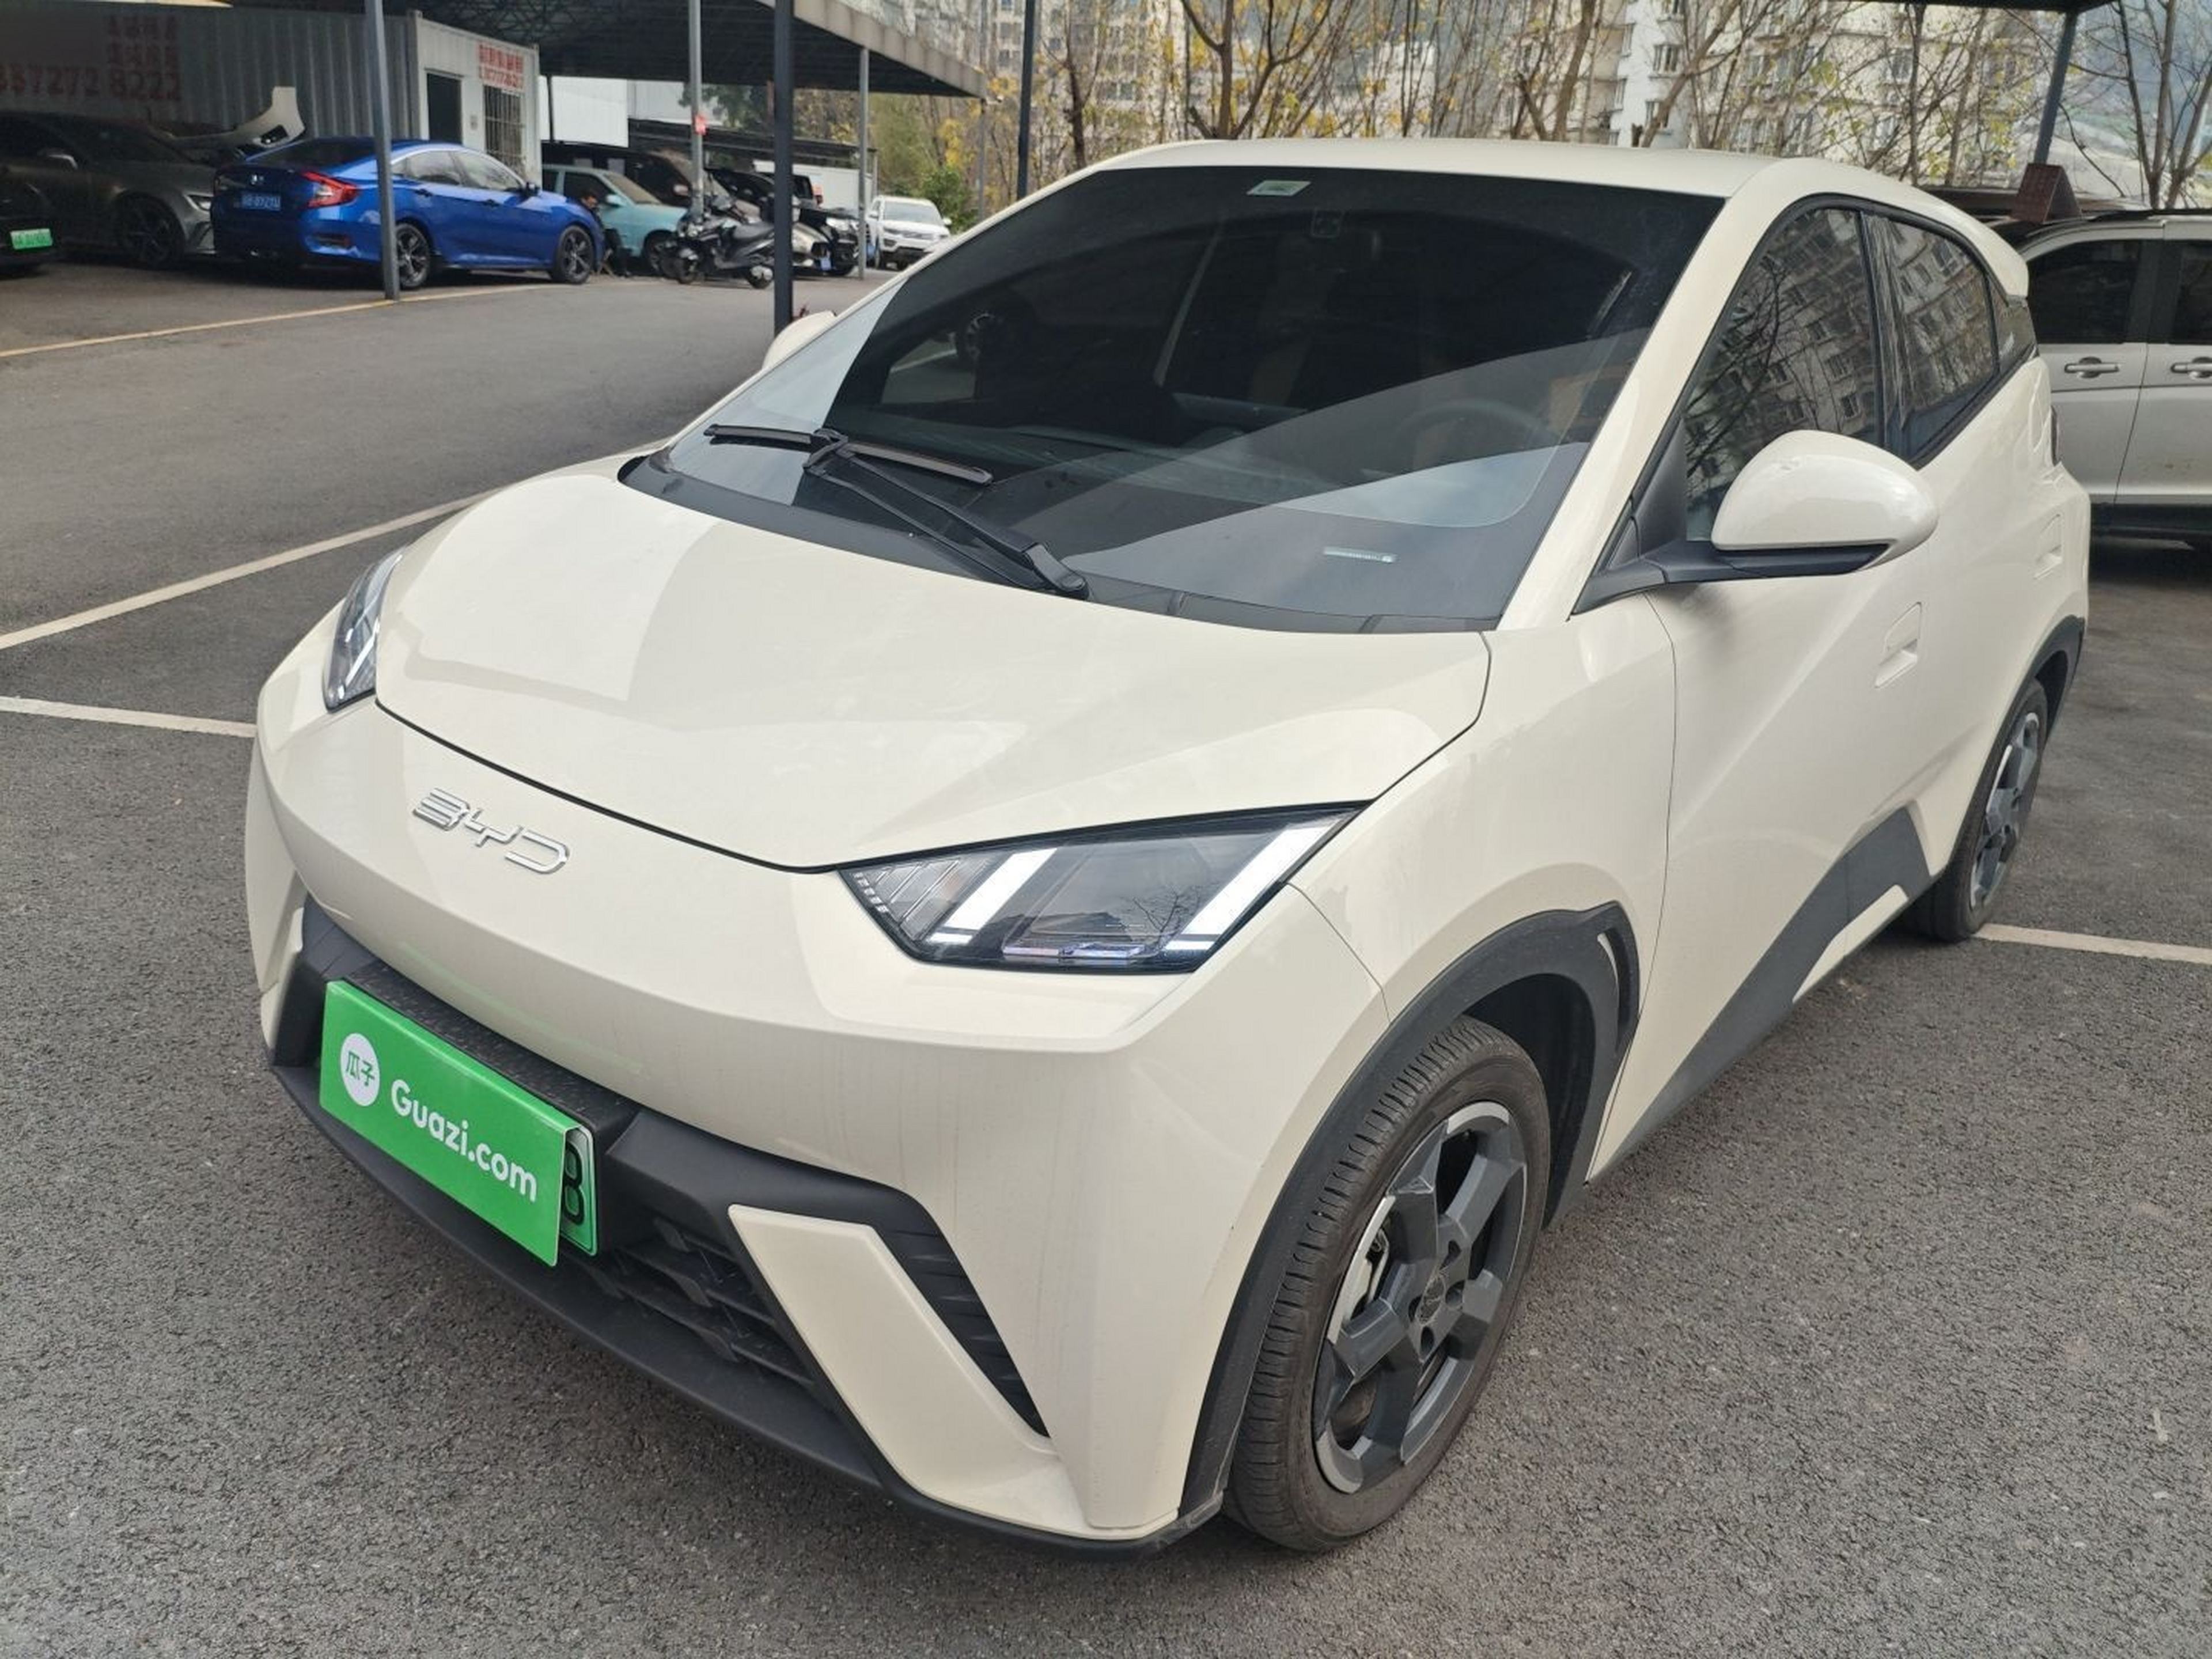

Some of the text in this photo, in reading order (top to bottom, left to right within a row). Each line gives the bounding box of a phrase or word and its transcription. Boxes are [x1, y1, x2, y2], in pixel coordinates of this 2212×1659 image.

[412, 787, 570, 874] BYD
[346, 1050, 375, 1086] 瓜子
[391, 1079, 537, 1203] Guazi.com
